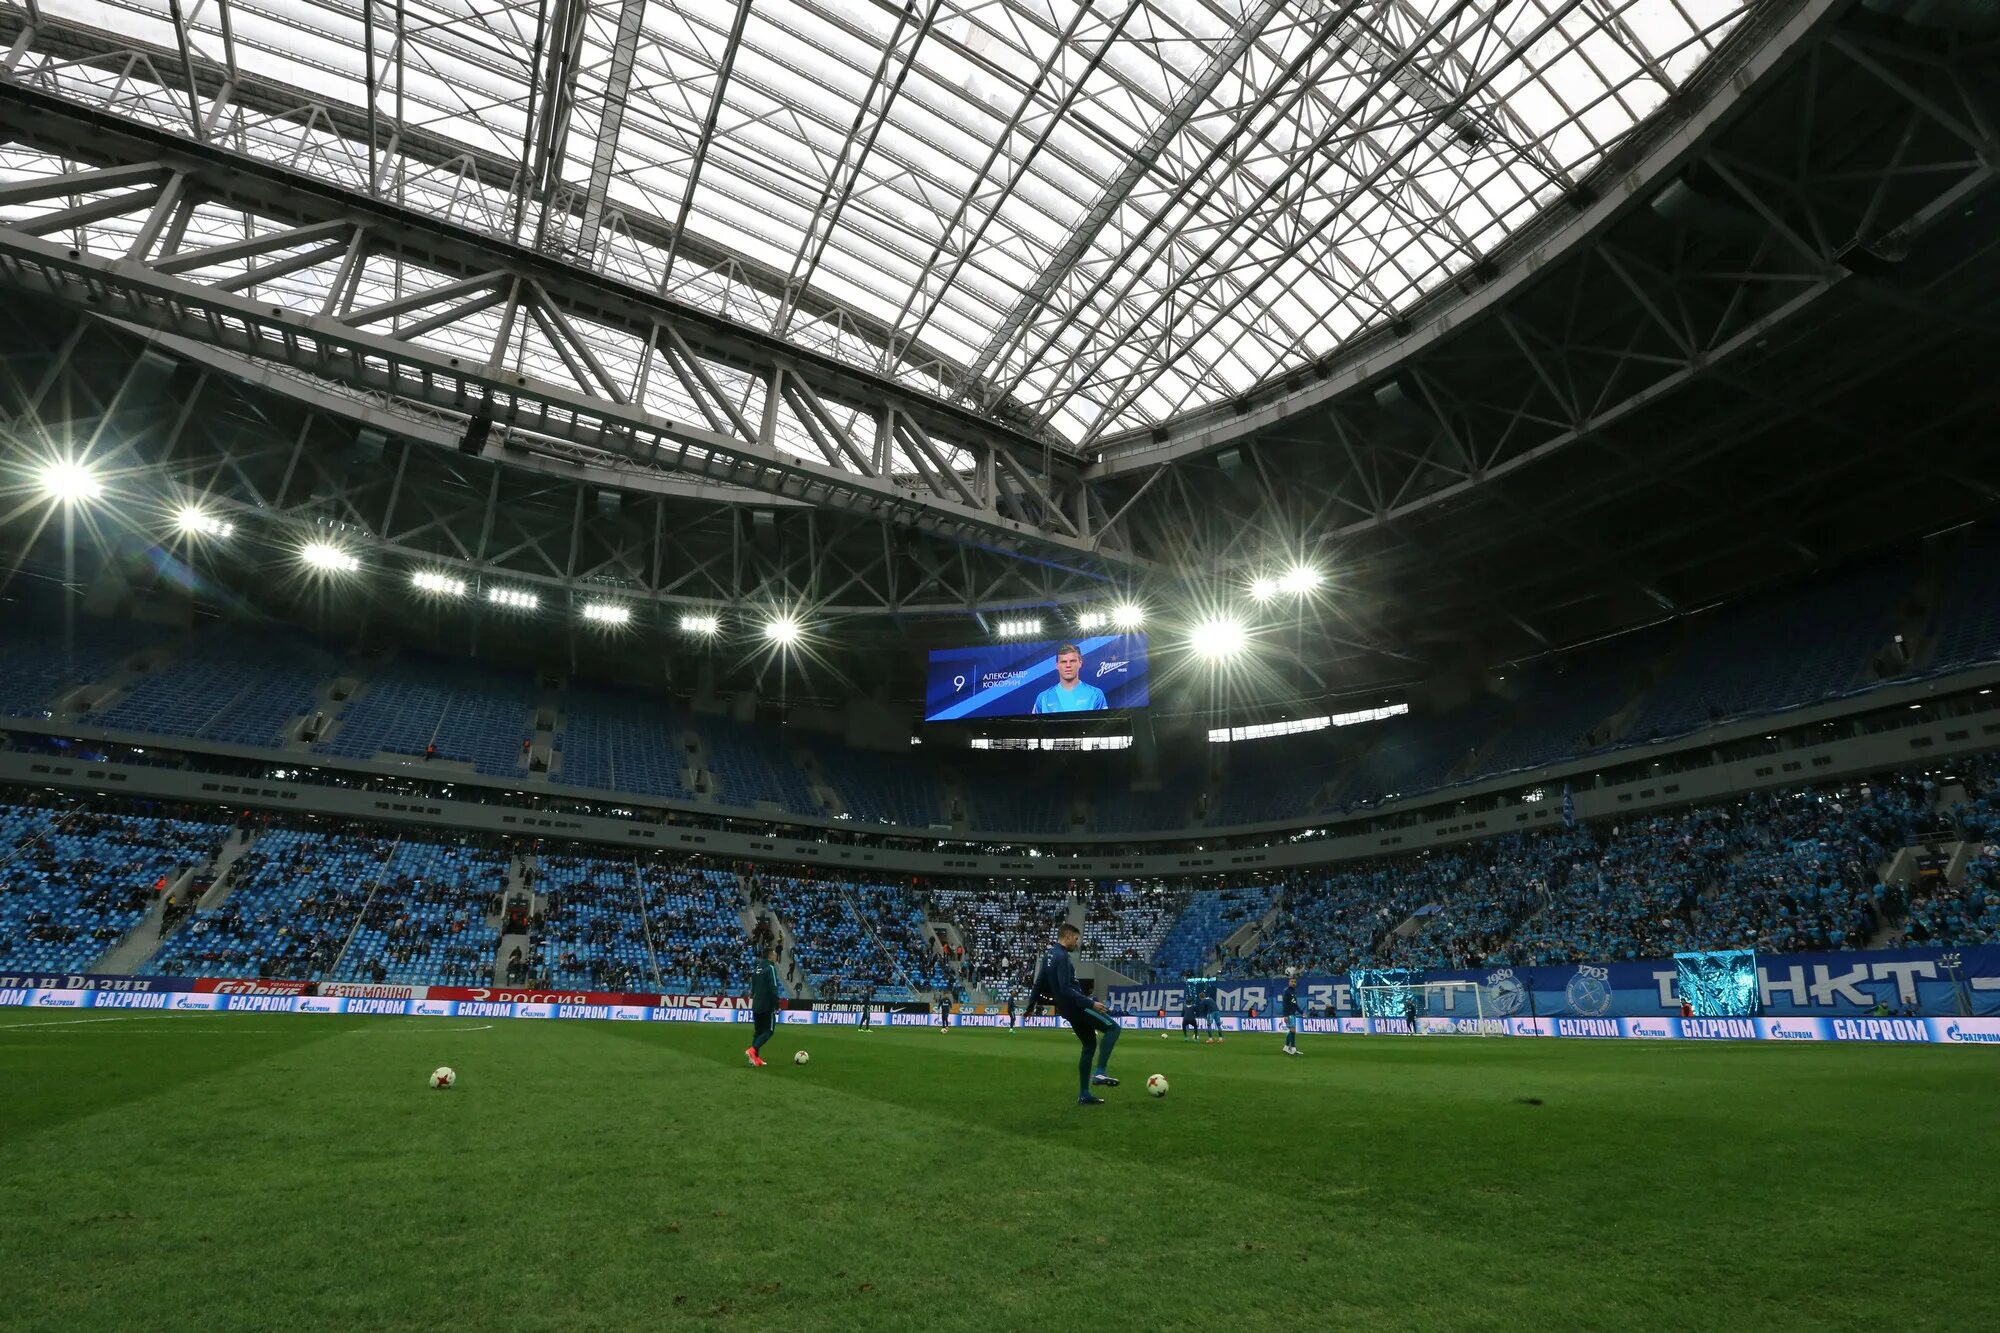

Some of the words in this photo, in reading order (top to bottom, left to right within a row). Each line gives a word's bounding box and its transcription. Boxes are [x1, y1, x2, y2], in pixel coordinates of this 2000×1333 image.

[953, 675, 965, 692] 9
[982, 671, 1028, 681] АЛЕКСАНДР
[982, 679, 1021, 689] КОКОРИН
[1486, 968, 1514, 985] 1980
[1577, 964, 1609, 981] 1703
[95, 992, 167, 1008] GAZPROM
[228, 996, 293, 1011] GAZPROM
[347, 999, 406, 1014] GAZPROM
[660, 995, 754, 1010] NISSAN
[1216, 986, 1268, 1012] МЯ
[458, 1002, 512, 1016] GAZPROM
[559, 1005, 609, 1019] GAZPROM
[653, 1008, 698, 1021] GAZPROM
[818, 1013, 857, 1024] GAZPROM
[892, 1014, 928, 1026] GAZPROM
[961, 1015, 995, 1026] GAZPROM
[1241, 1018, 1272, 1031] GAZPROM
[1303, 1018, 1339, 1032] GAZPROM
[1559, 1020, 1619, 1037] GAZPROM
[1681, 1019, 1756, 1038] GAZPROM
[1833, 1019, 1929, 1041] GAZPROM
